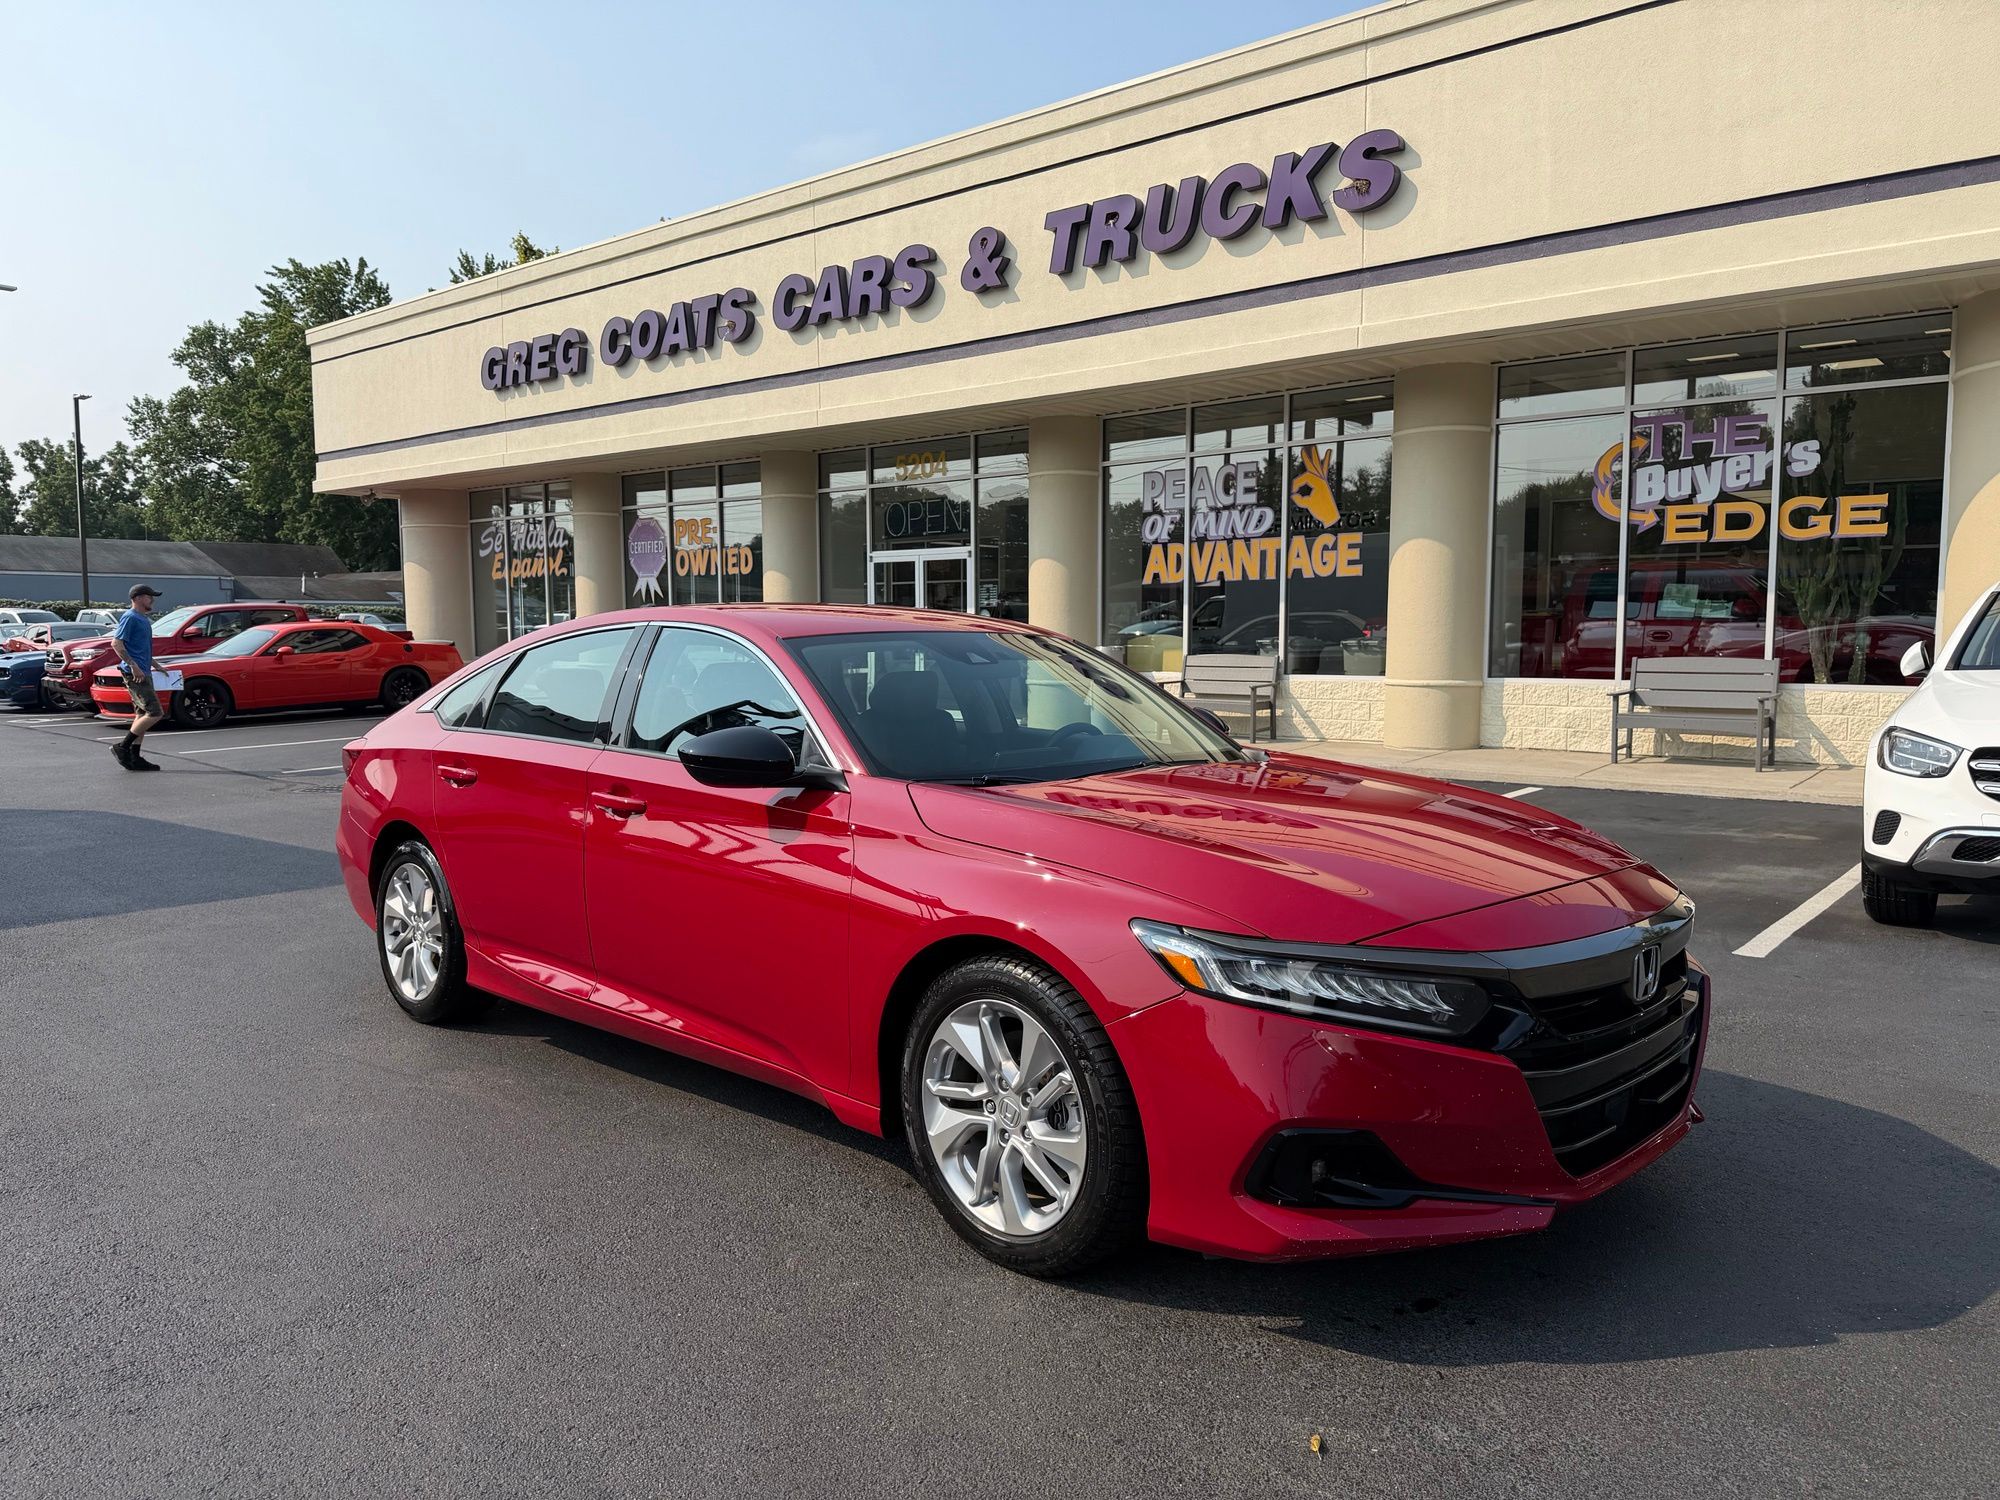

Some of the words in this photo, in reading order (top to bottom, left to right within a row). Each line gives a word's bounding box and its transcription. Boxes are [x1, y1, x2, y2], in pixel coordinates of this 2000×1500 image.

[481, 327, 588, 391] GREG
[600, 287, 756, 367] COATS
[772, 244, 937, 331] CARS
[961, 226, 1011, 295] &
[1043, 128, 1406, 275] TRUCKS
[1632, 413, 1768, 463] THE
[895, 451, 949, 482] 5204
[1631, 438, 1822, 505] Buyer's
[1142, 461, 1259, 513] PEACE
[674, 517, 718, 546] PRE-
[885, 498, 963, 537] OPEN
[1141, 513, 1182, 544] OF
[1190, 506, 1275, 540] MIND
[1661, 493, 1889, 545] EDGE
[479, 526, 504, 558] Se
[629, 540, 665, 555] CERTIFIED
[675, 546, 754, 577] OWNED
[1141, 531, 1364, 586] ADVANTAGE
[491, 548, 568, 588] Epañl
